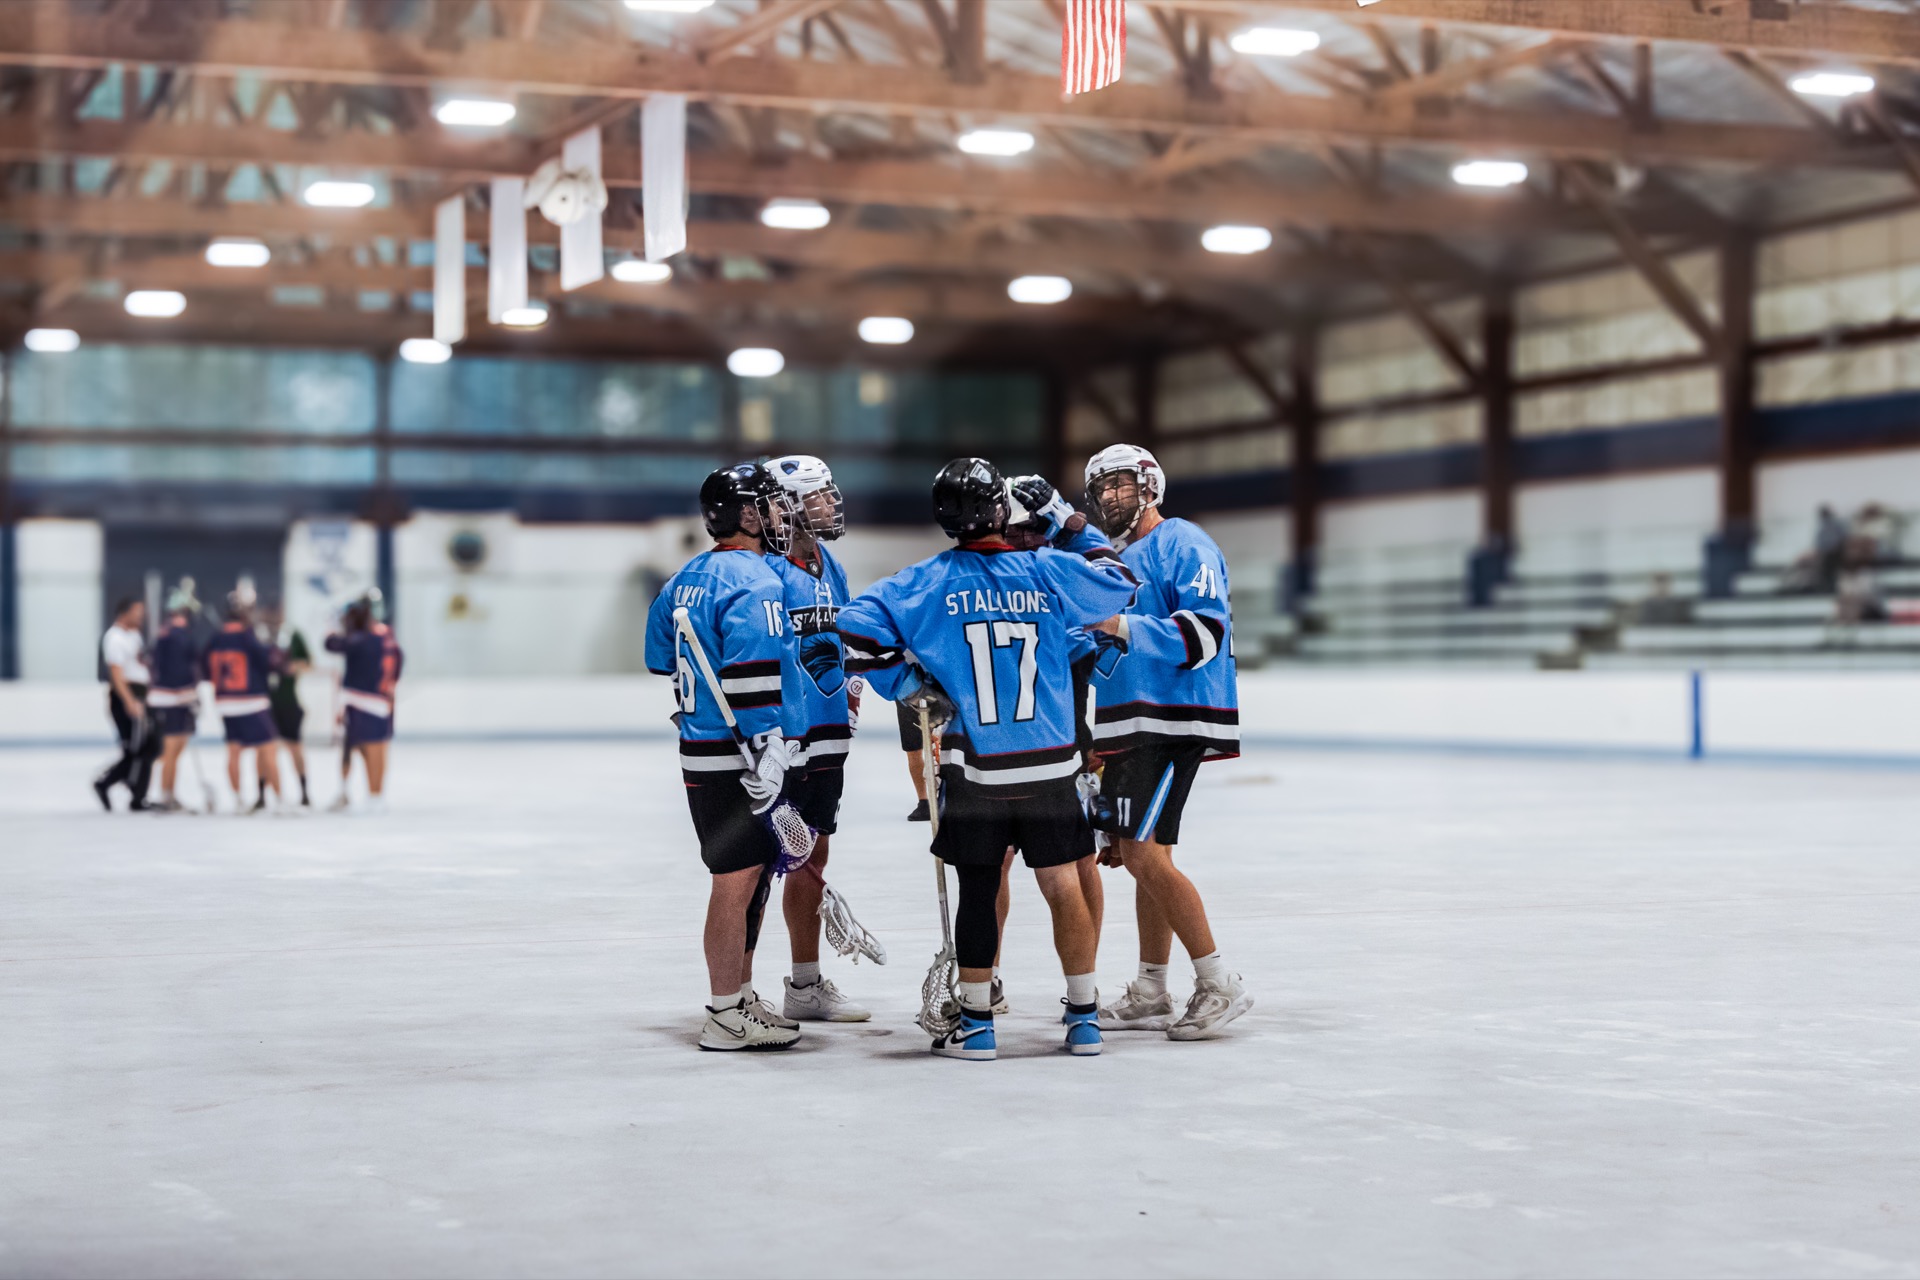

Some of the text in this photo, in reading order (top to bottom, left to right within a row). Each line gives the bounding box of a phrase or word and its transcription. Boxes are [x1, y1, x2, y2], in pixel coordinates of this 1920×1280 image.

[1189, 562, 1217, 600] 41
[761, 599, 784, 638] 16
[945, 588, 1051, 616] STALLIONS
[963, 619, 1040, 727] 17
